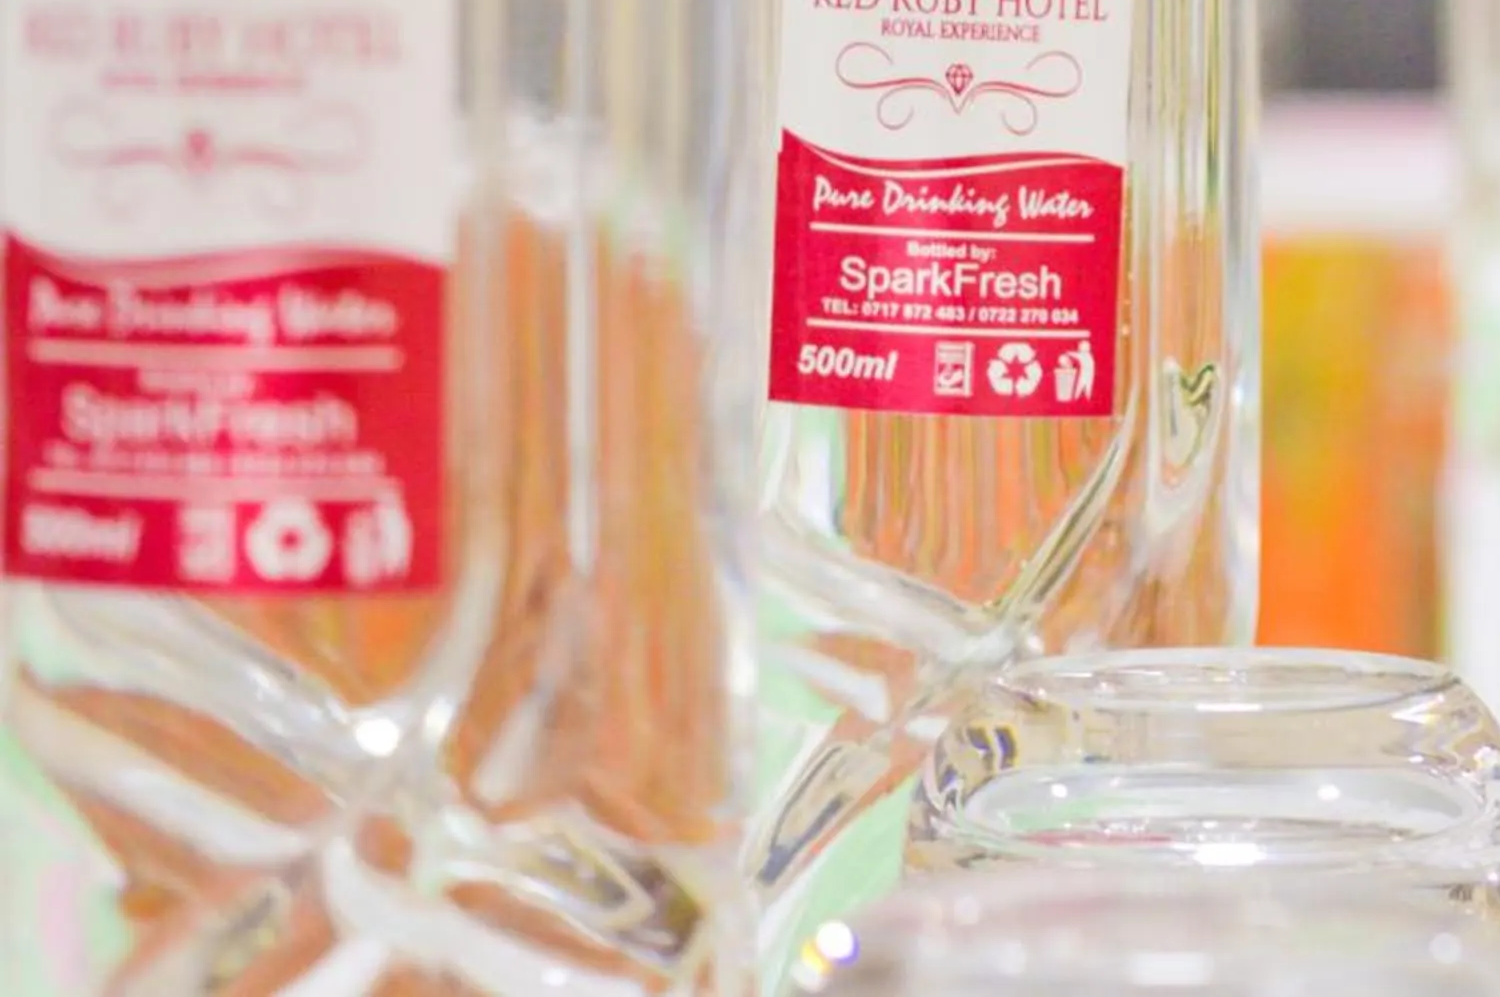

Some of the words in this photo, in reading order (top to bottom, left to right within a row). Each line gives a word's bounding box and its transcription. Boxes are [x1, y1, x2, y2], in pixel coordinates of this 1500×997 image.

[881, 20, 936, 39] ROYAL
[940, 22, 1041, 43] EXPERIENCE
[812, 175, 875, 211] Pure
[882, 179, 1011, 229] Drinking
[1018, 186, 1094, 220] Water
[906, 240, 967, 260] Bottled
[970, 243, 998, 263] by:
[839, 256, 1063, 300] SparkFresh
[821, 296, 859, 316] TEL:
[798, 343, 898, 381] 500ml
